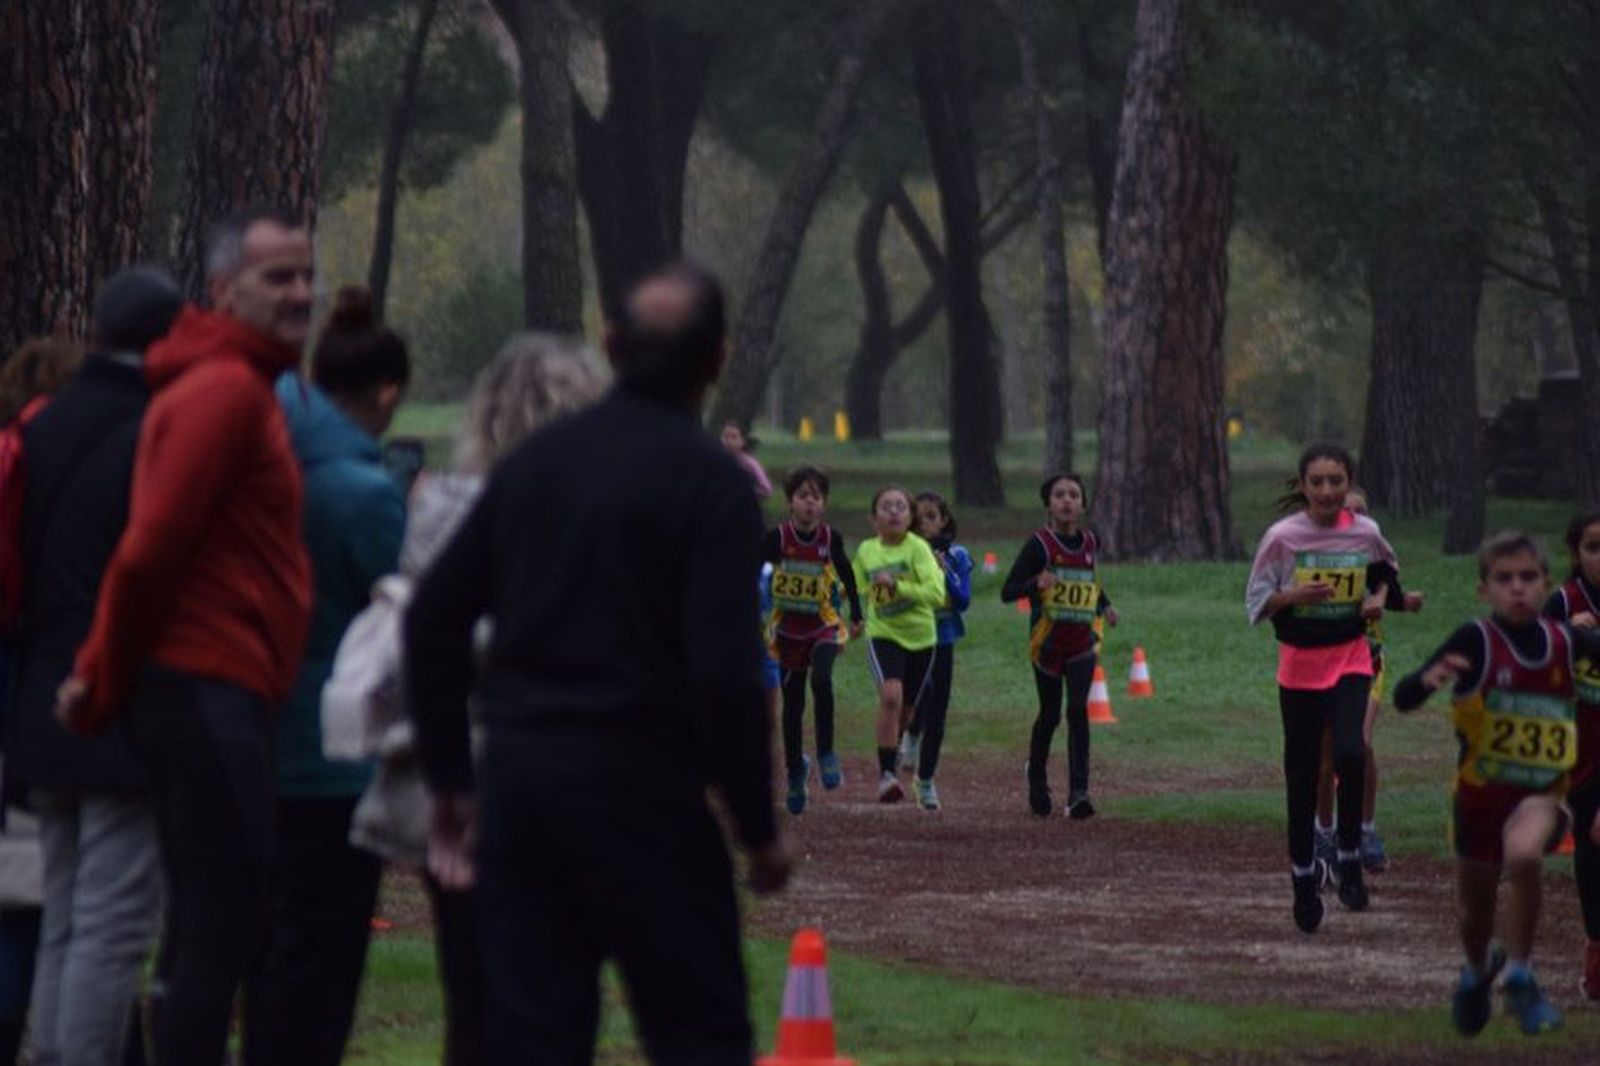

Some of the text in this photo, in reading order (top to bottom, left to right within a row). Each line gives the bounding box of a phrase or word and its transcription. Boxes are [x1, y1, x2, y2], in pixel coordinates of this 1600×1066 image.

[775, 574, 818, 598] 234
[1053, 582, 1092, 606] 207
[1490, 718, 1566, 761] 233
